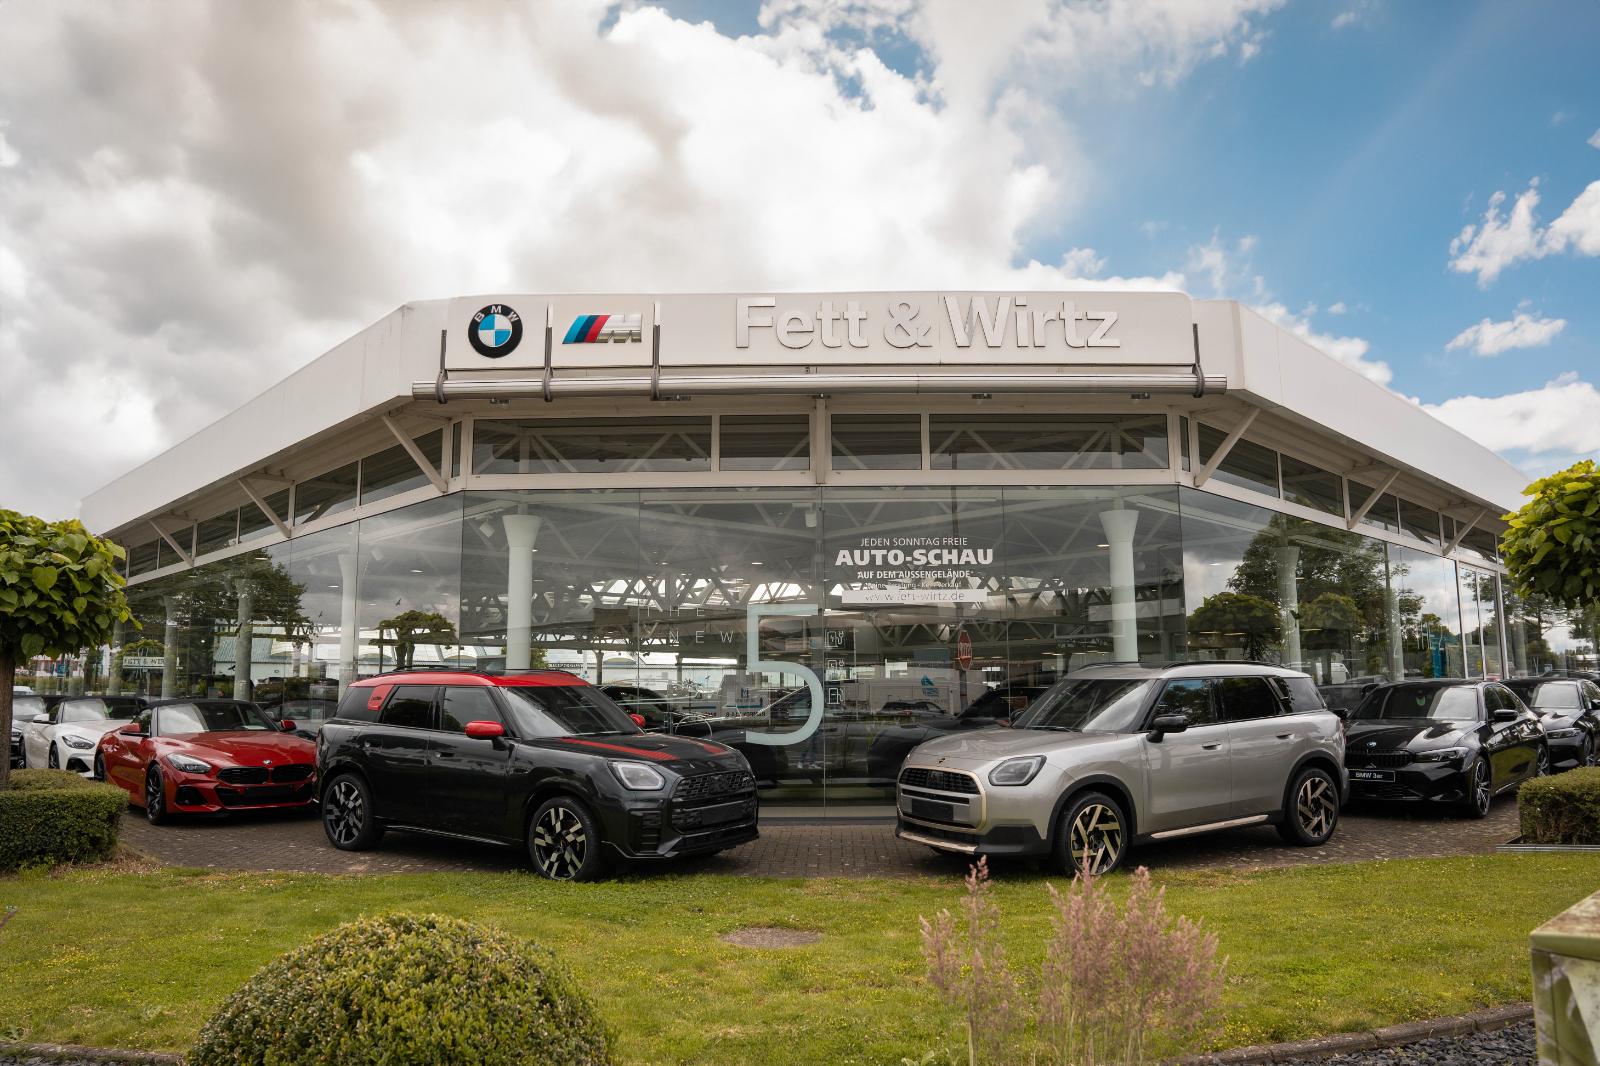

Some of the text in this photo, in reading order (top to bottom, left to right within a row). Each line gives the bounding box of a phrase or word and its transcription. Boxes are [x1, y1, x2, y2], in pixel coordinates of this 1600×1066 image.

[473, 304, 520, 323] BMW
[735, 295, 1122, 350] Fett & Wirtz
[860, 537, 968, 547] JEDEN SONNTAG FREIE
[835, 549, 993, 566] AUTO-SCHAU
[857, 568, 971, 579] AUF DEM AUSSENGELÄNDE
[668, 629, 734, 644] NEW
[745, 603, 825, 747] 5
